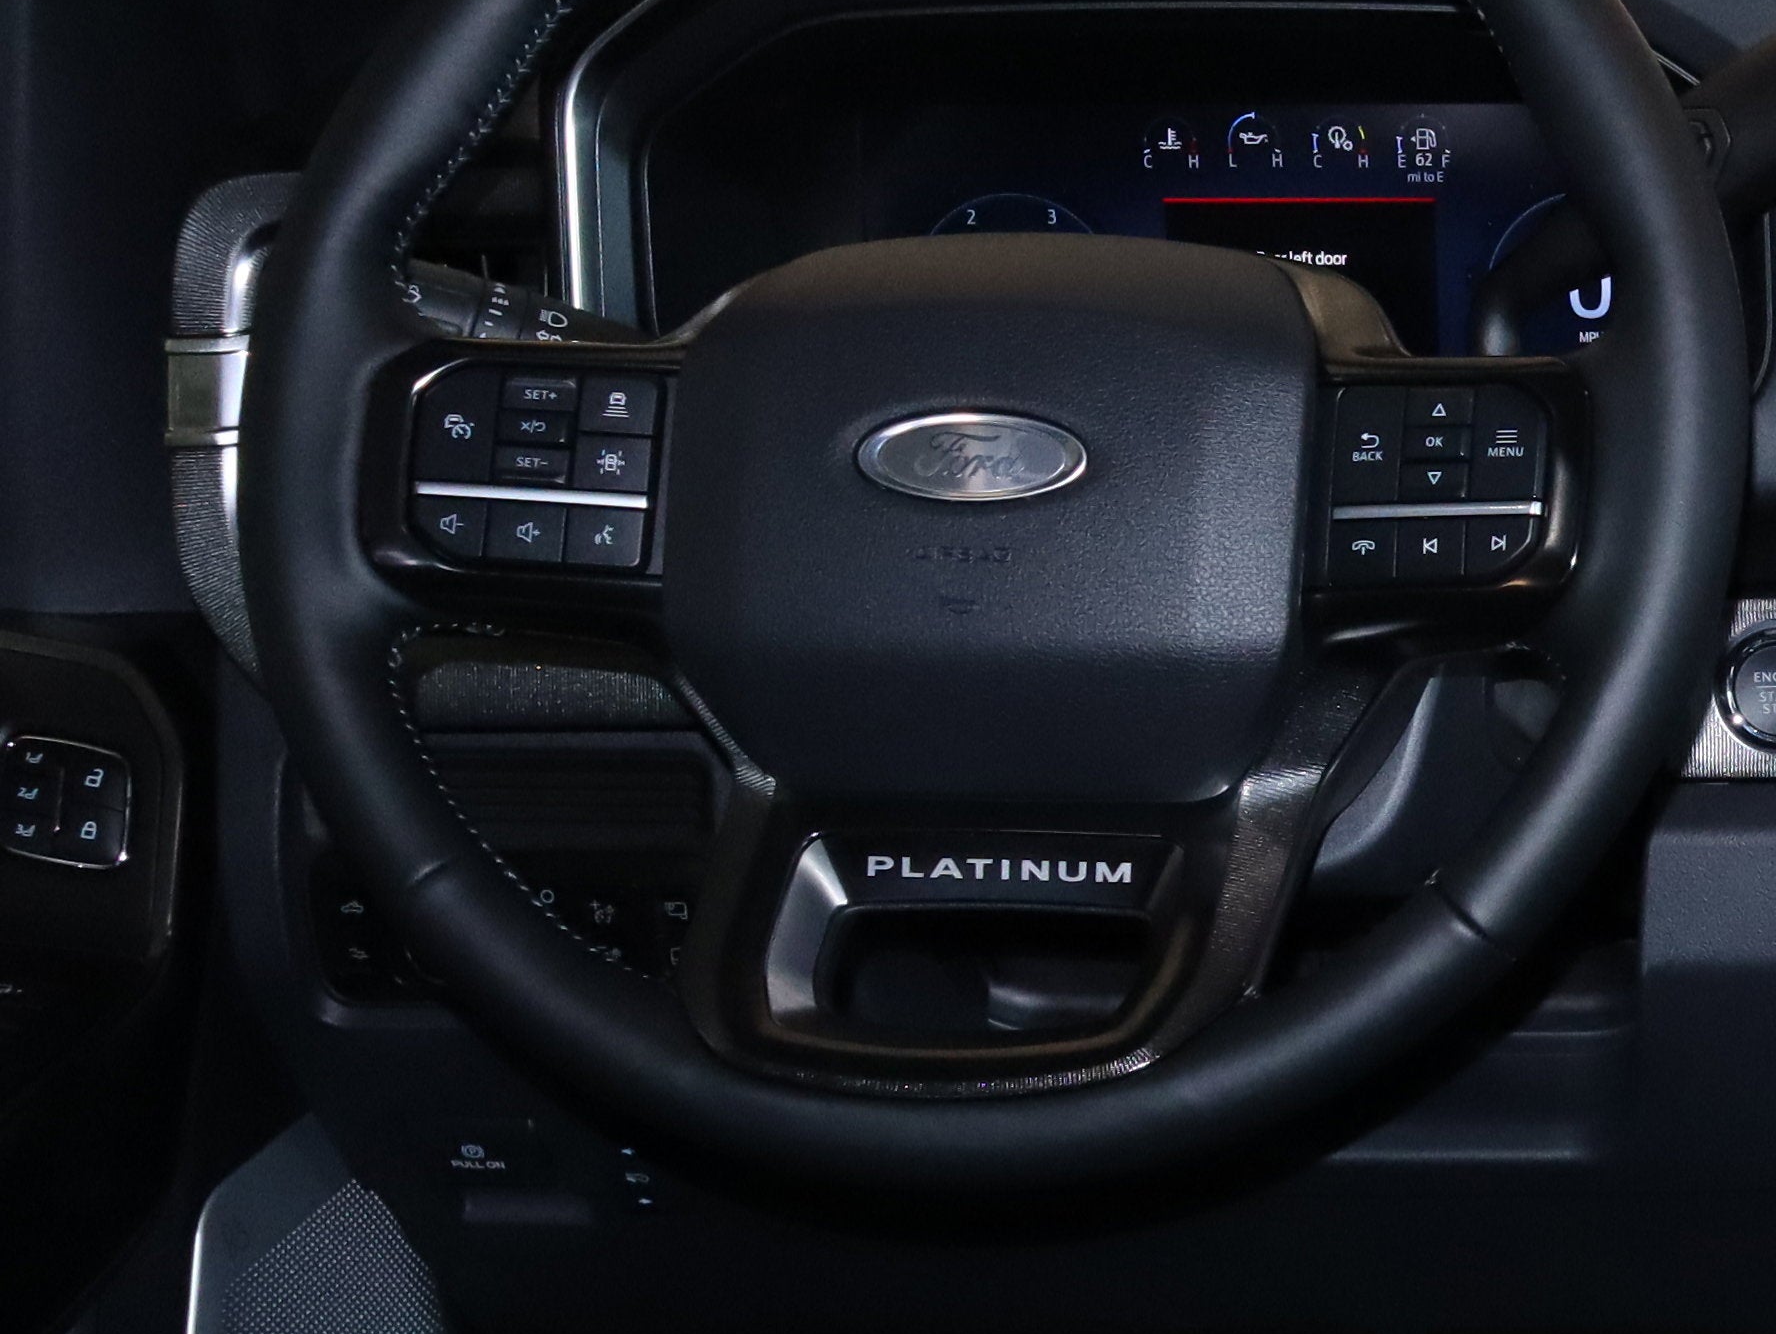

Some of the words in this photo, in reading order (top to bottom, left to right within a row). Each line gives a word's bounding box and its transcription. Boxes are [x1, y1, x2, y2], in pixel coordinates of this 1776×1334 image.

[1188, 154, 1199, 168] H
[1272, 154, 1283, 168] H
[1358, 154, 1368, 168] H
[1415, 153, 1433, 166] 62
[1407, 172, 1420, 183] mi
[1423, 172, 1435, 183] to
[966, 209, 976, 225] 2
[1047, 209, 1057, 225] 3
[1315, 251, 1347, 266] door
[1425, 436, 1444, 448] OK
[914, 431, 1026, 478] Ford
[1352, 451, 1383, 462] BACK
[1487, 446, 1524, 458] MENU
[866, 855, 1133, 884] PLATINUM
